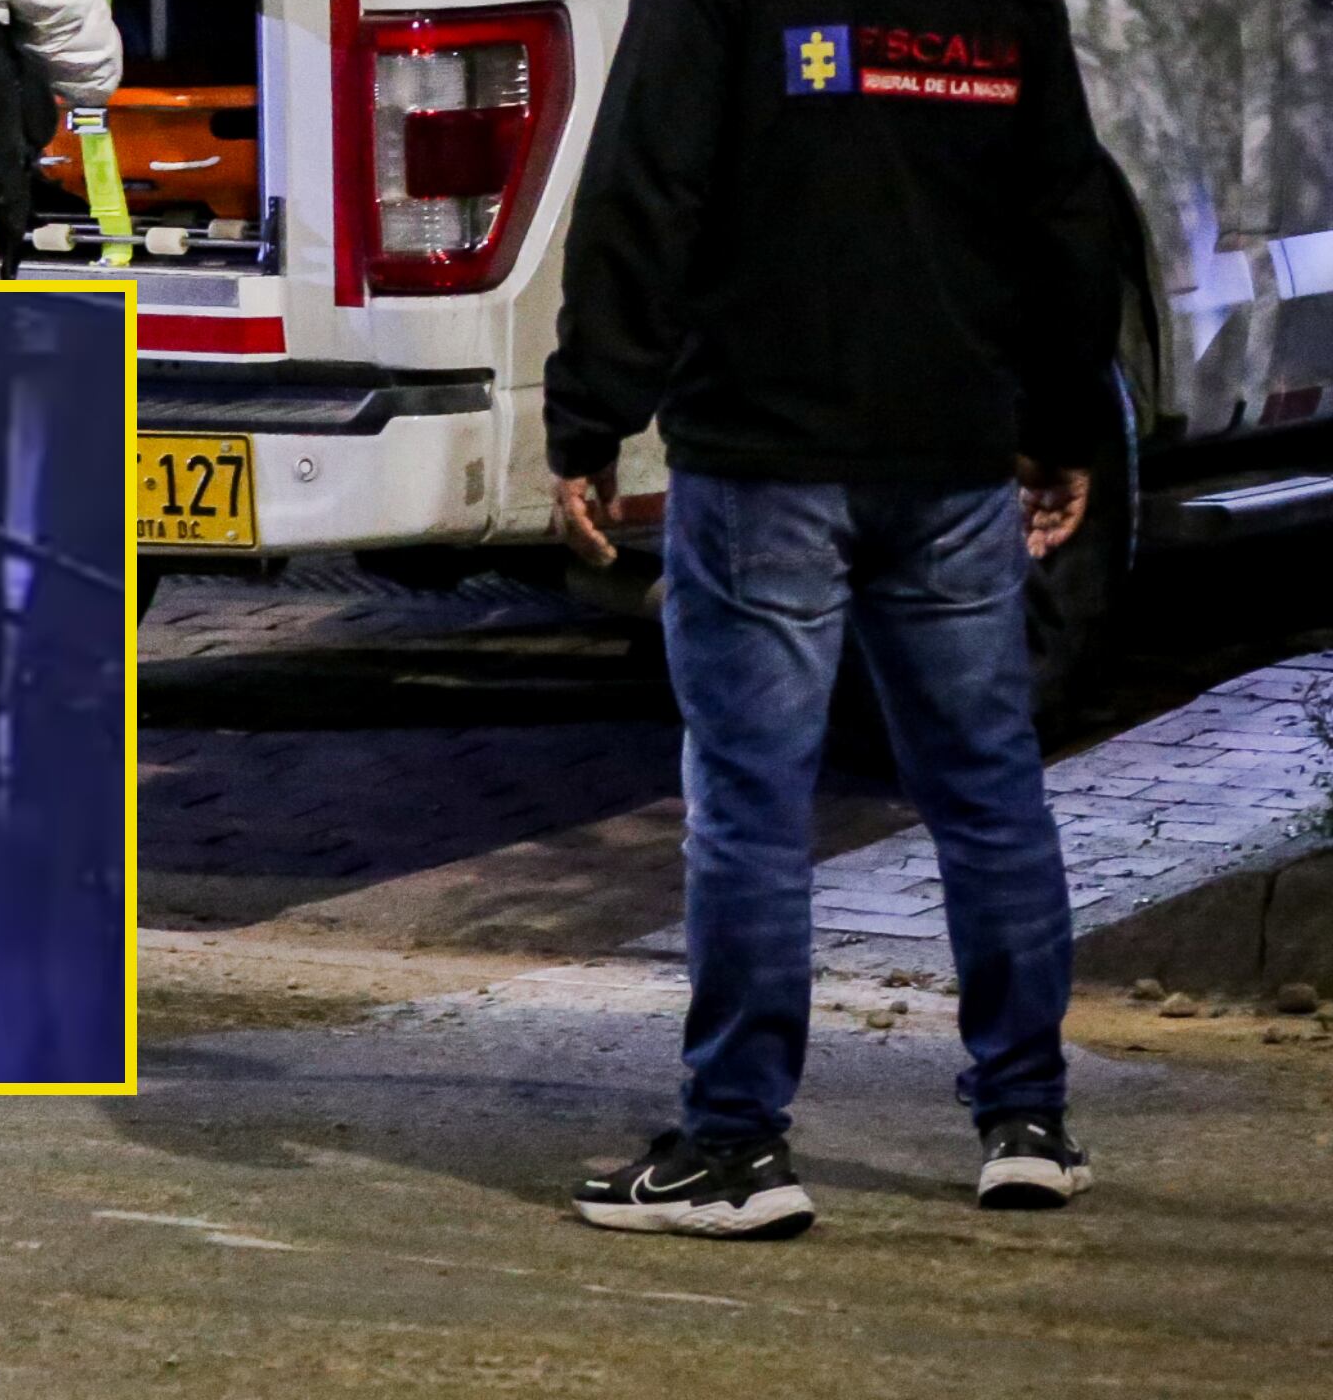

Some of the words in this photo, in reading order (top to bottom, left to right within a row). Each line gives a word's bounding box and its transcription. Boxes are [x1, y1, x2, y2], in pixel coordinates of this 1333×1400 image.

[924, 77, 946, 93] DE
[950, 80, 970, 95] LA
[159, 453, 244, 517] 127
